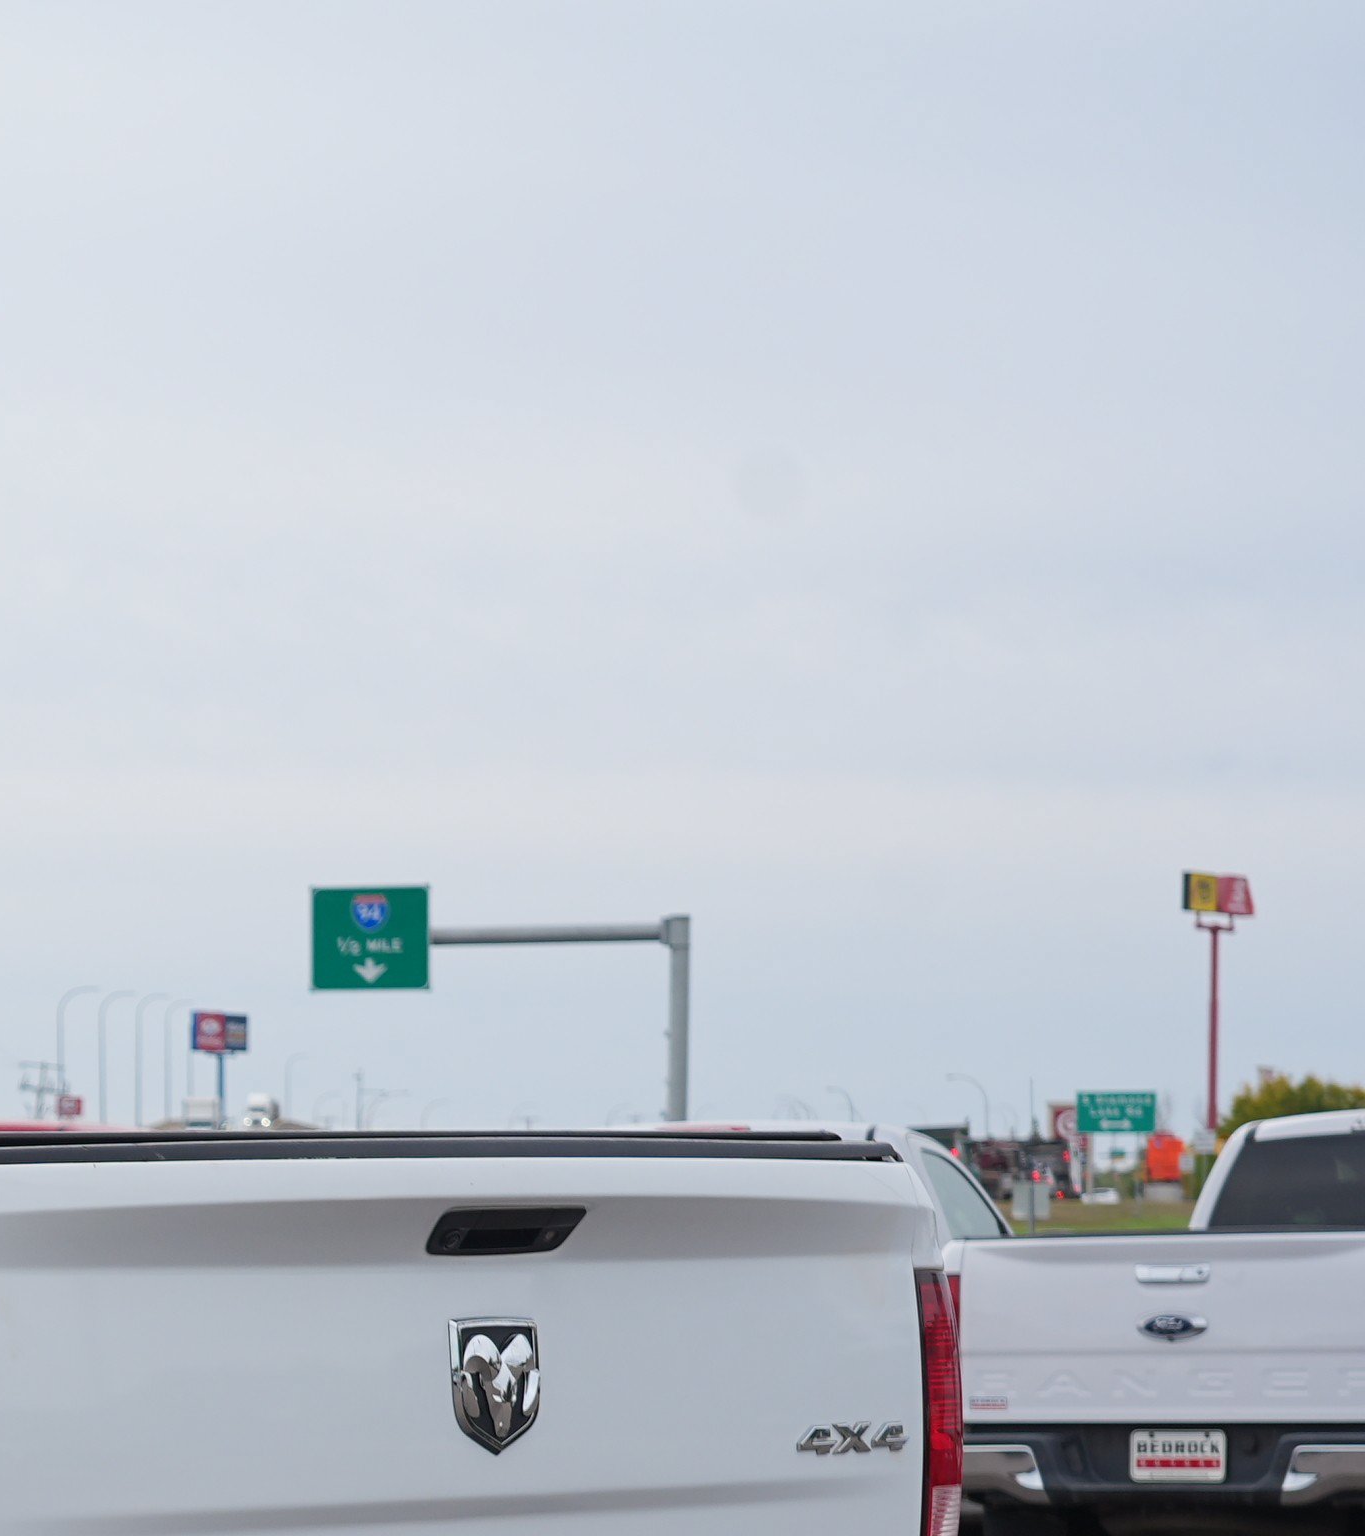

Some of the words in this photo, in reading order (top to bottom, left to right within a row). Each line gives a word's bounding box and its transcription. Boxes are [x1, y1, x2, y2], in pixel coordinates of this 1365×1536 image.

[357, 903, 382, 921] 94
[366, 937, 404, 953] MILE
[1137, 1440, 1220, 1453] BEDROCK
